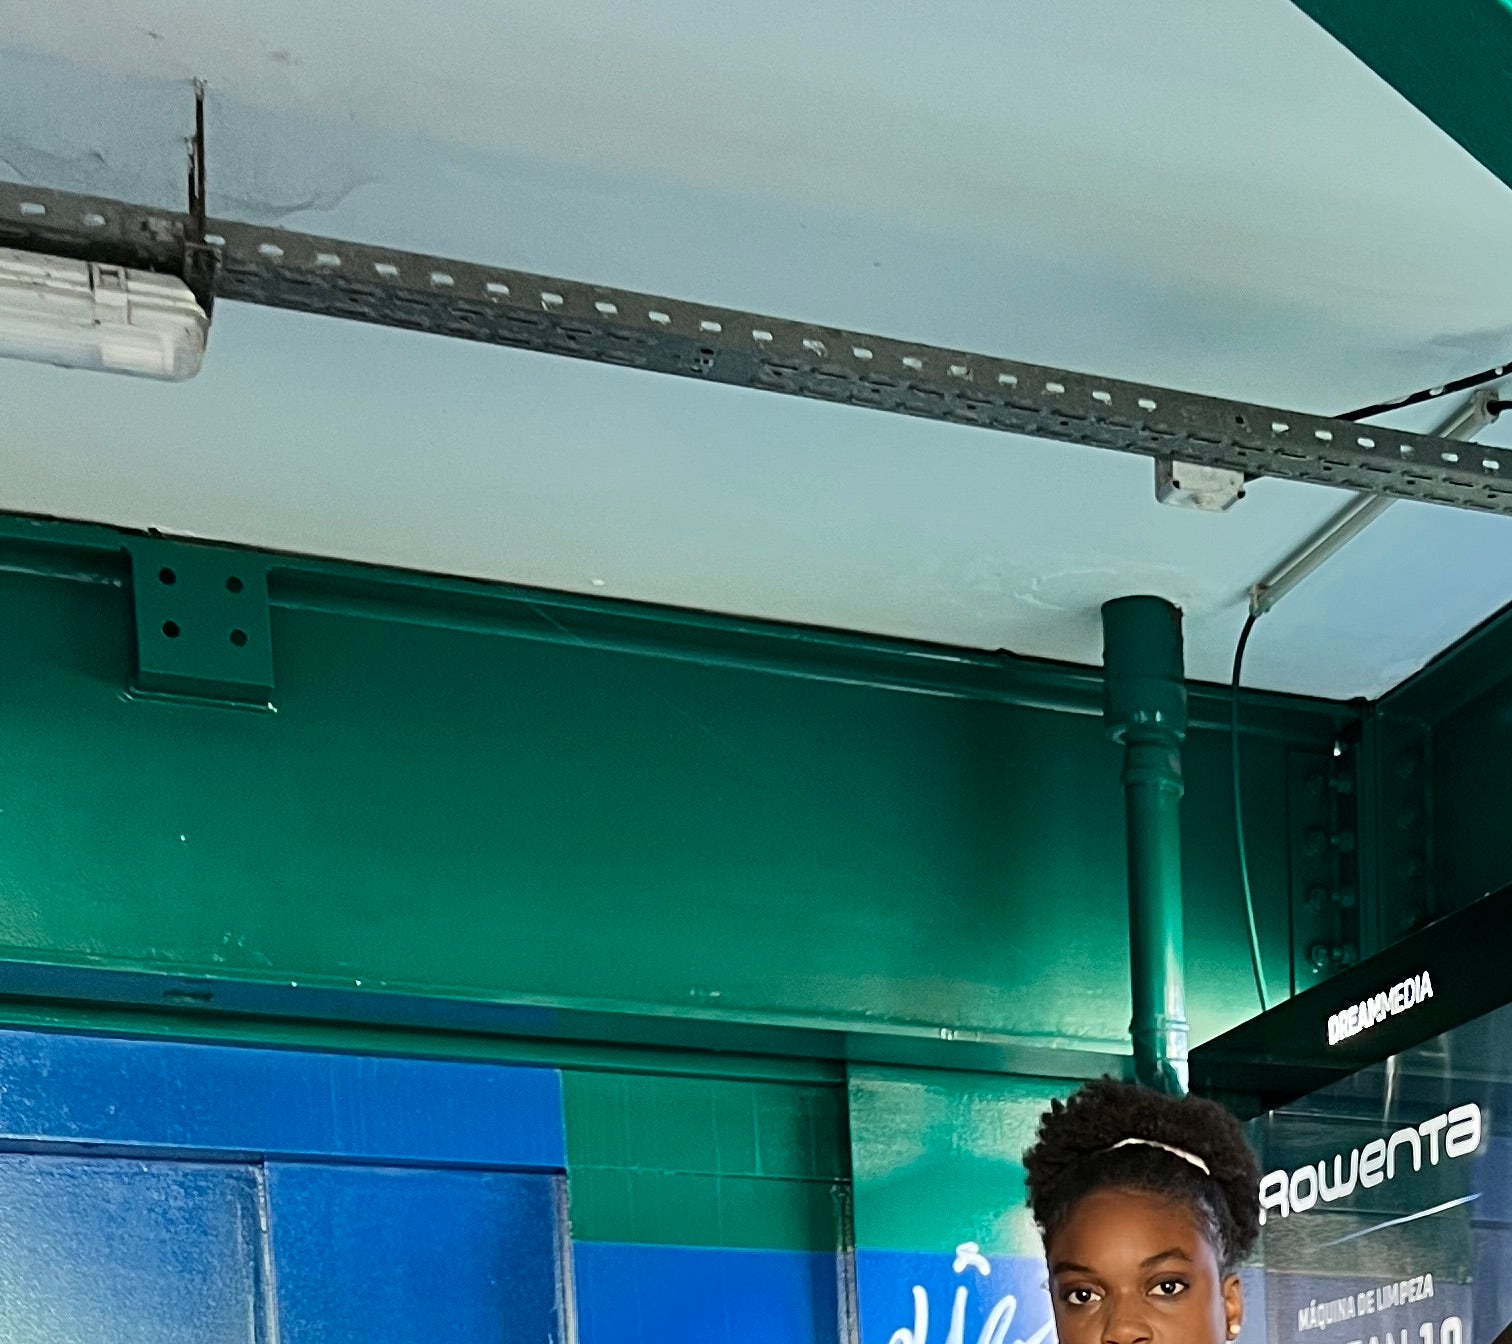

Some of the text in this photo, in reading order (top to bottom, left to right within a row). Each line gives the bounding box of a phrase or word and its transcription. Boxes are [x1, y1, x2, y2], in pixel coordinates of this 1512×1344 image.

[1327, 970, 1433, 1046] DREAMMEDIA
[1297, 1273, 1435, 1332] MÁQUINA DE LIMPEZA
